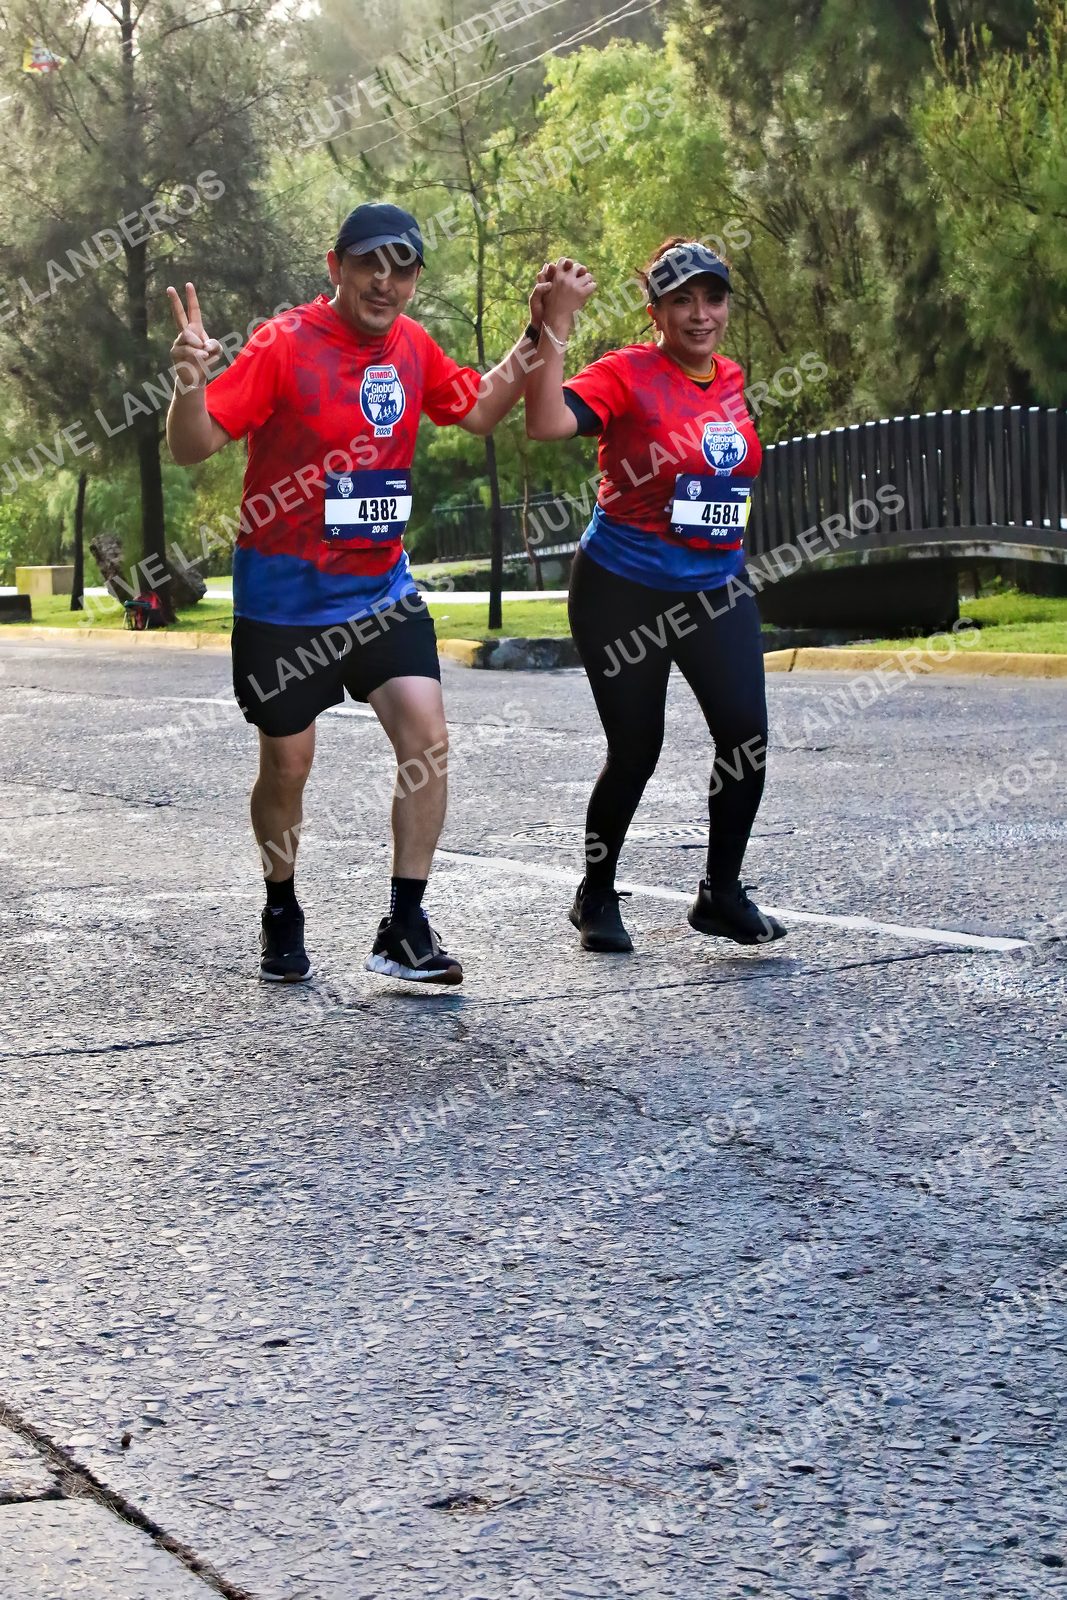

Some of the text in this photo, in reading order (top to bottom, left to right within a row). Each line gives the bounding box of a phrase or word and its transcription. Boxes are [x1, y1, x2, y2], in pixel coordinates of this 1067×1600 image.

[370, 371, 392, 379] BIMBO
[372, 381, 395, 394] Global
[368, 393, 387, 403] Race
[376, 428, 392, 436] 2026
[710, 443, 729, 451] Race
[358, 498, 398, 522] 4382
[702, 504, 739, 524] 4584
